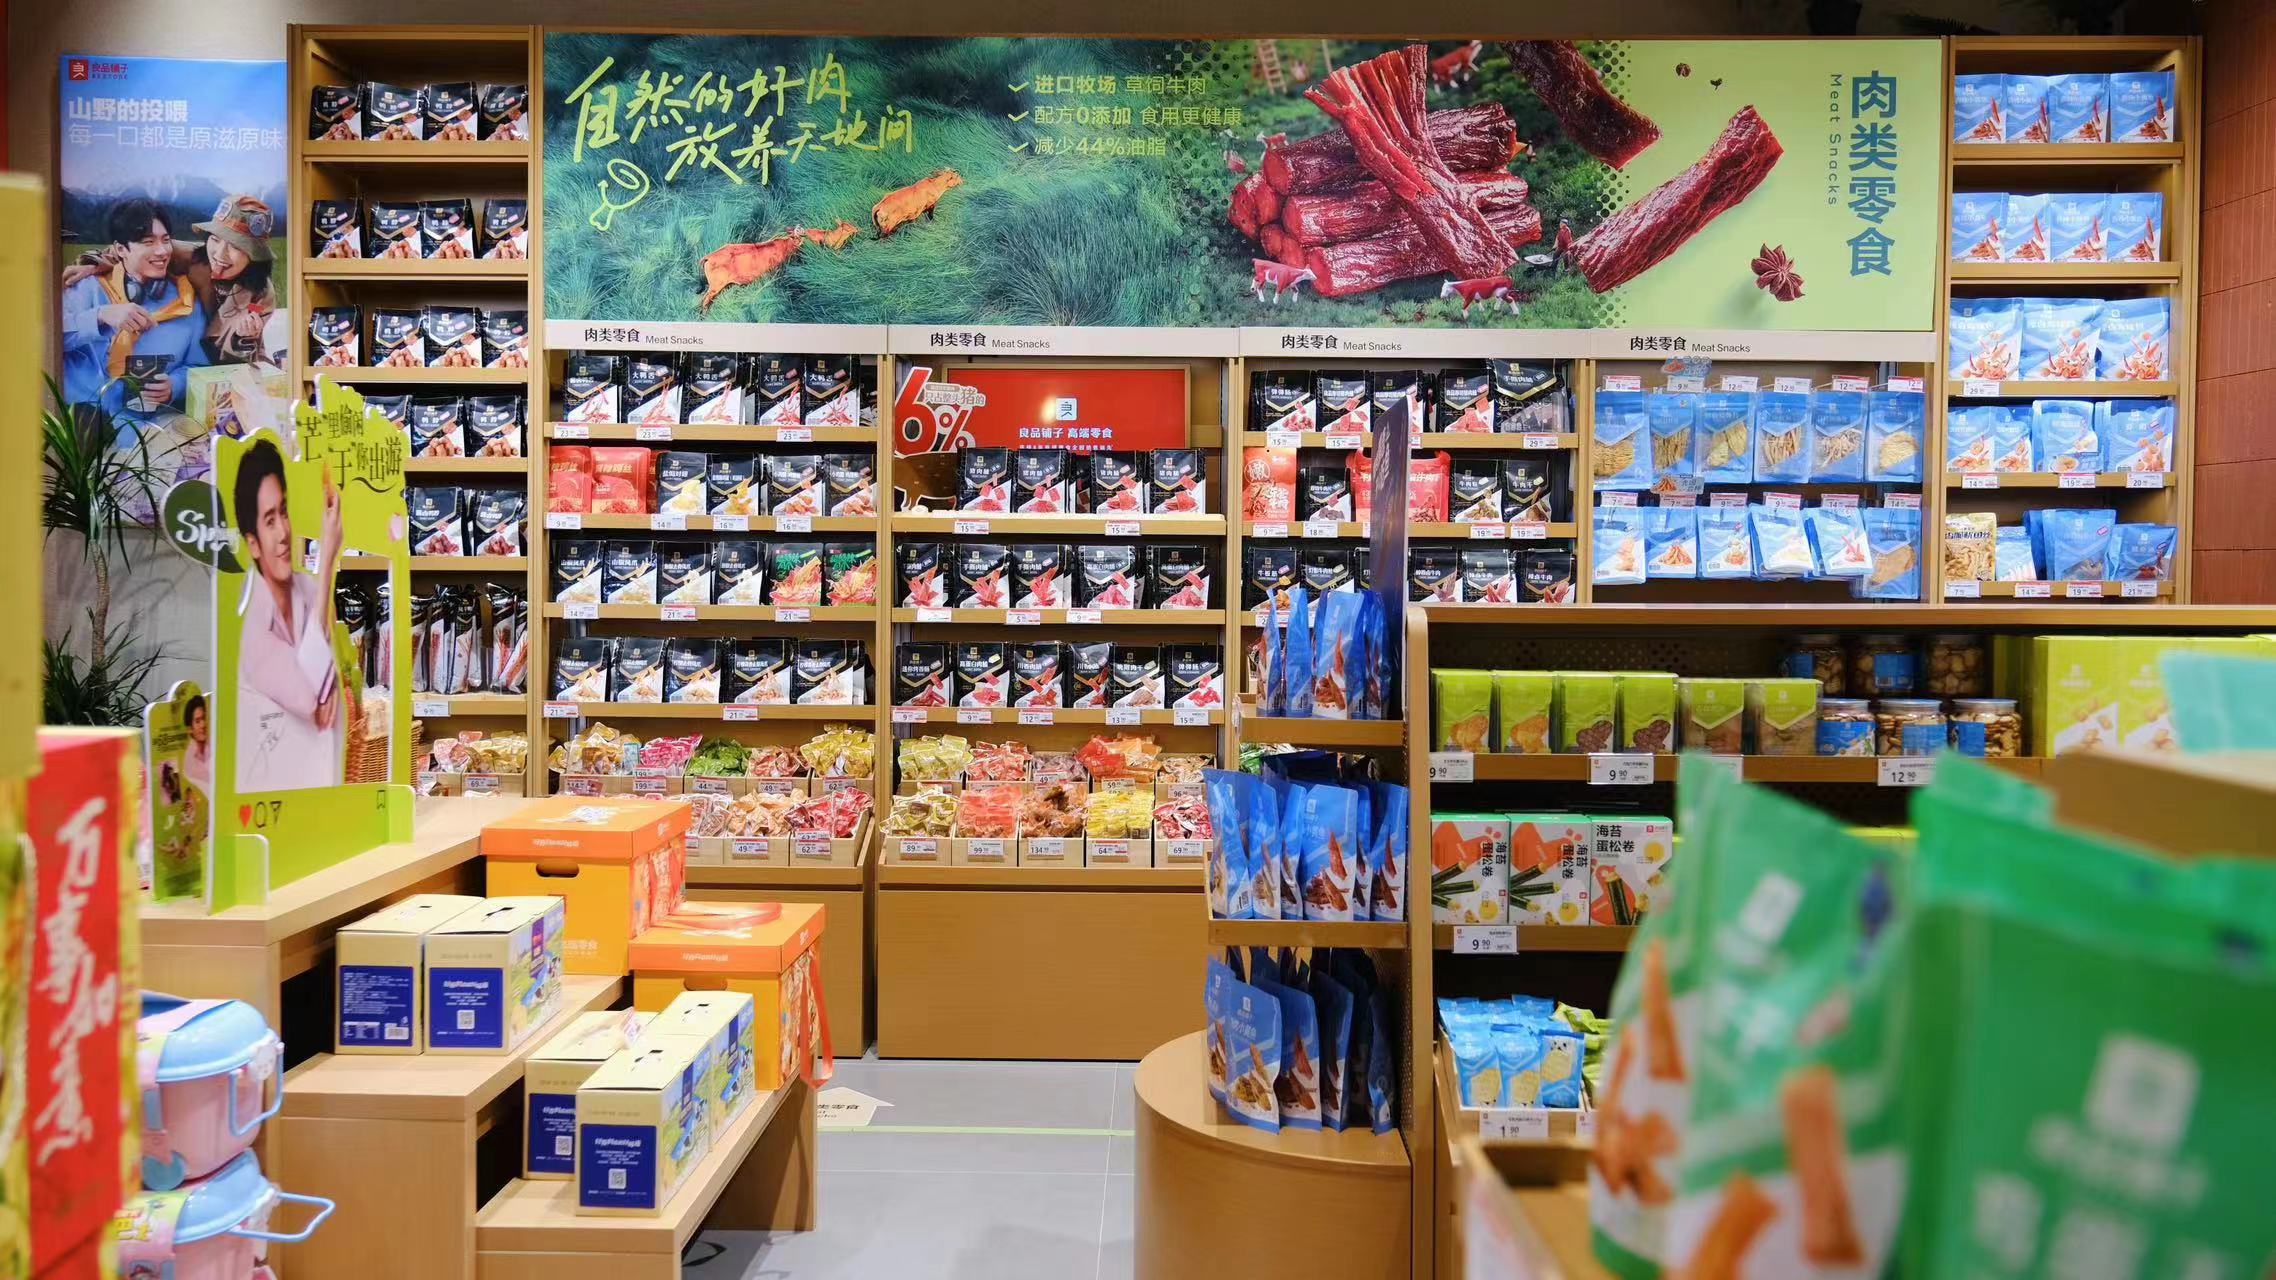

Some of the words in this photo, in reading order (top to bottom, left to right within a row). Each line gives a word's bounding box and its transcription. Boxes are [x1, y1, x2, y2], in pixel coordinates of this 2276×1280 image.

[1034, 75, 1116, 95] 进口牧场
[1124, 75, 1206, 95] 草饲牛肉
[1829, 73, 1843, 124] Meat
[68, 96, 189, 122] 山野的投喂
[565, 52, 852, 163] 自然的好肉
[1034, 105, 1132, 126] 配方0添加
[1140, 106, 1243, 126] 食用更健康
[69, 123, 284, 151] 每一口都是原滋原味
[665, 104, 913, 185] 放养天地间
[1034, 136, 1167, 157] 减少44%油脂
[1827, 133, 1842, 206] Snacks
[1846, 69, 1898, 277] 肉类零食
[584, 327, 640, 343] 肉类零食
[645, 334, 669, 345] Meat
[670, 335, 704, 345] Snacks
[930, 332, 987, 347] 肉类零食
[1281, 334, 1338, 350] 肉类零食
[991, 339, 1015, 349] Meat
[1016, 339, 1051, 349] Snacks
[1343, 341, 1367, 351] Meat
[1368, 341, 1402, 352] Snacks
[1630, 336, 1687, 351] 肉类零食
[1691, 343, 1715, 353] Meat
[1716, 343, 1750, 353] Snacks
[1019, 427, 1064, 439] 良品铺子
[1067, 427, 1113, 439] 高端零食
[1429, 767, 1436, 778] 9
[1609, 769, 1616, 781] 9
[1891, 771, 1905, 783] 12
[1596, 824, 1622, 838] 海苔
[1495, 841, 1508, 865] 海苔
[1596, 839, 1635, 853] 蛋松卷
[1481, 841, 1494, 878] 蛋松卷
[1562, 844, 1575, 880] 蛋松卷
[1576, 844, 1589, 867] 海苔
[1472, 939, 1479, 950] 9
